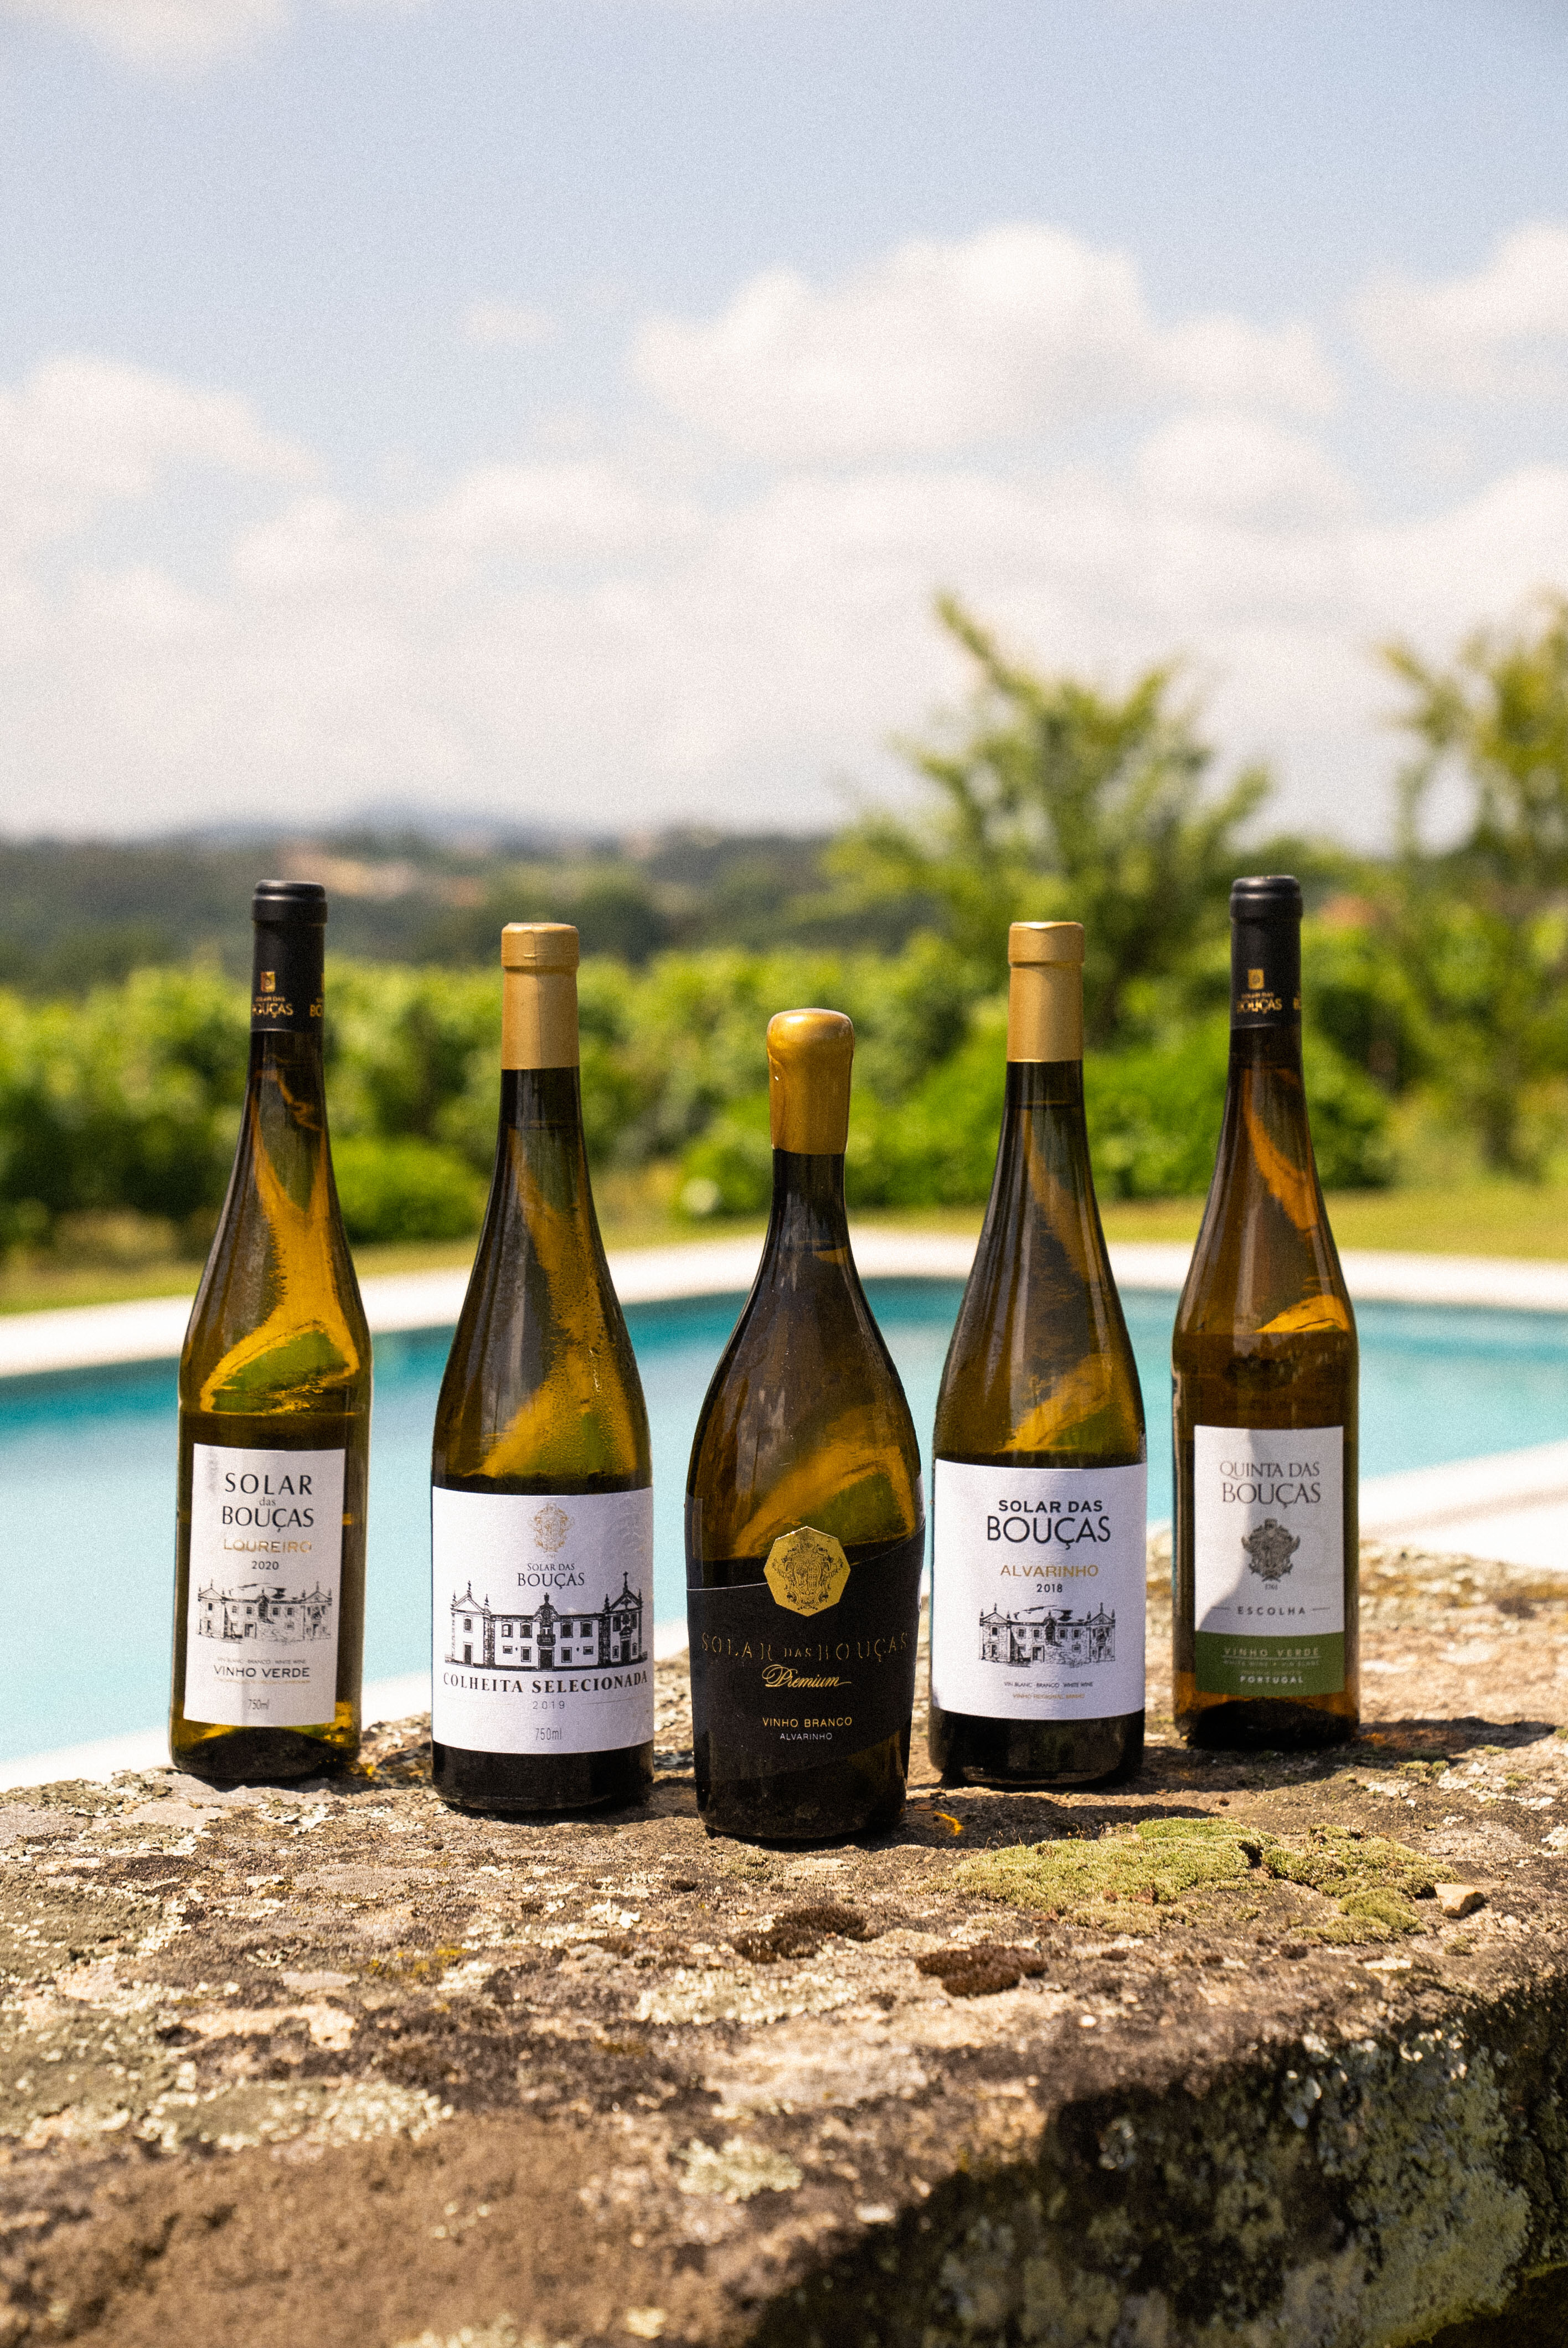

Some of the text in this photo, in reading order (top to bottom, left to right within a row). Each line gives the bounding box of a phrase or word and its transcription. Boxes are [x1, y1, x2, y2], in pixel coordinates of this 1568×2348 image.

[1220, 1461, 1320, 1480] QUINTA DAS
[225, 1472, 312, 1495] SOLAR
[259, 1497, 276, 1506] das
[1223, 1482, 1321, 1509] BOUÇAS
[998, 1500, 1103, 1513] SOLAR DAS
[222, 1506, 314, 1533] BOUÇAS
[987, 1515, 1111, 1550] BOUÇAS
[224, 1539, 312, 1553] LOUREIRO
[252, 1561, 279, 1571] 2020
[527, 1563, 556, 1571] SOLAR
[1000, 1564, 1098, 1577] ALVARINHO
[518, 1572, 585, 1589] BOUÇAS
[1036, 1583, 1063, 1593] 2018
[1237, 1606, 1305, 1616] ESCOLHA
[702, 1632, 907, 1662] SOLAR DAS BOUÇAS
[1224, 1647, 1319, 1657] VINHO VERDE
[213, 1665, 310, 1678] VINHO VERDE
[762, 1664, 852, 1688] Premium
[443, 1670, 648, 1693] COLHEITA SELECIONADA
[1240, 1675, 1303, 1685] PORTUGAL
[248, 1698, 270, 1710] 750ml
[533, 1700, 565, 1710] 2019
[762, 1717, 853, 1728] VINHO BRANCO
[535, 1727, 562, 1741] 750ml
[780, 1732, 833, 1741] ALVARINHO
